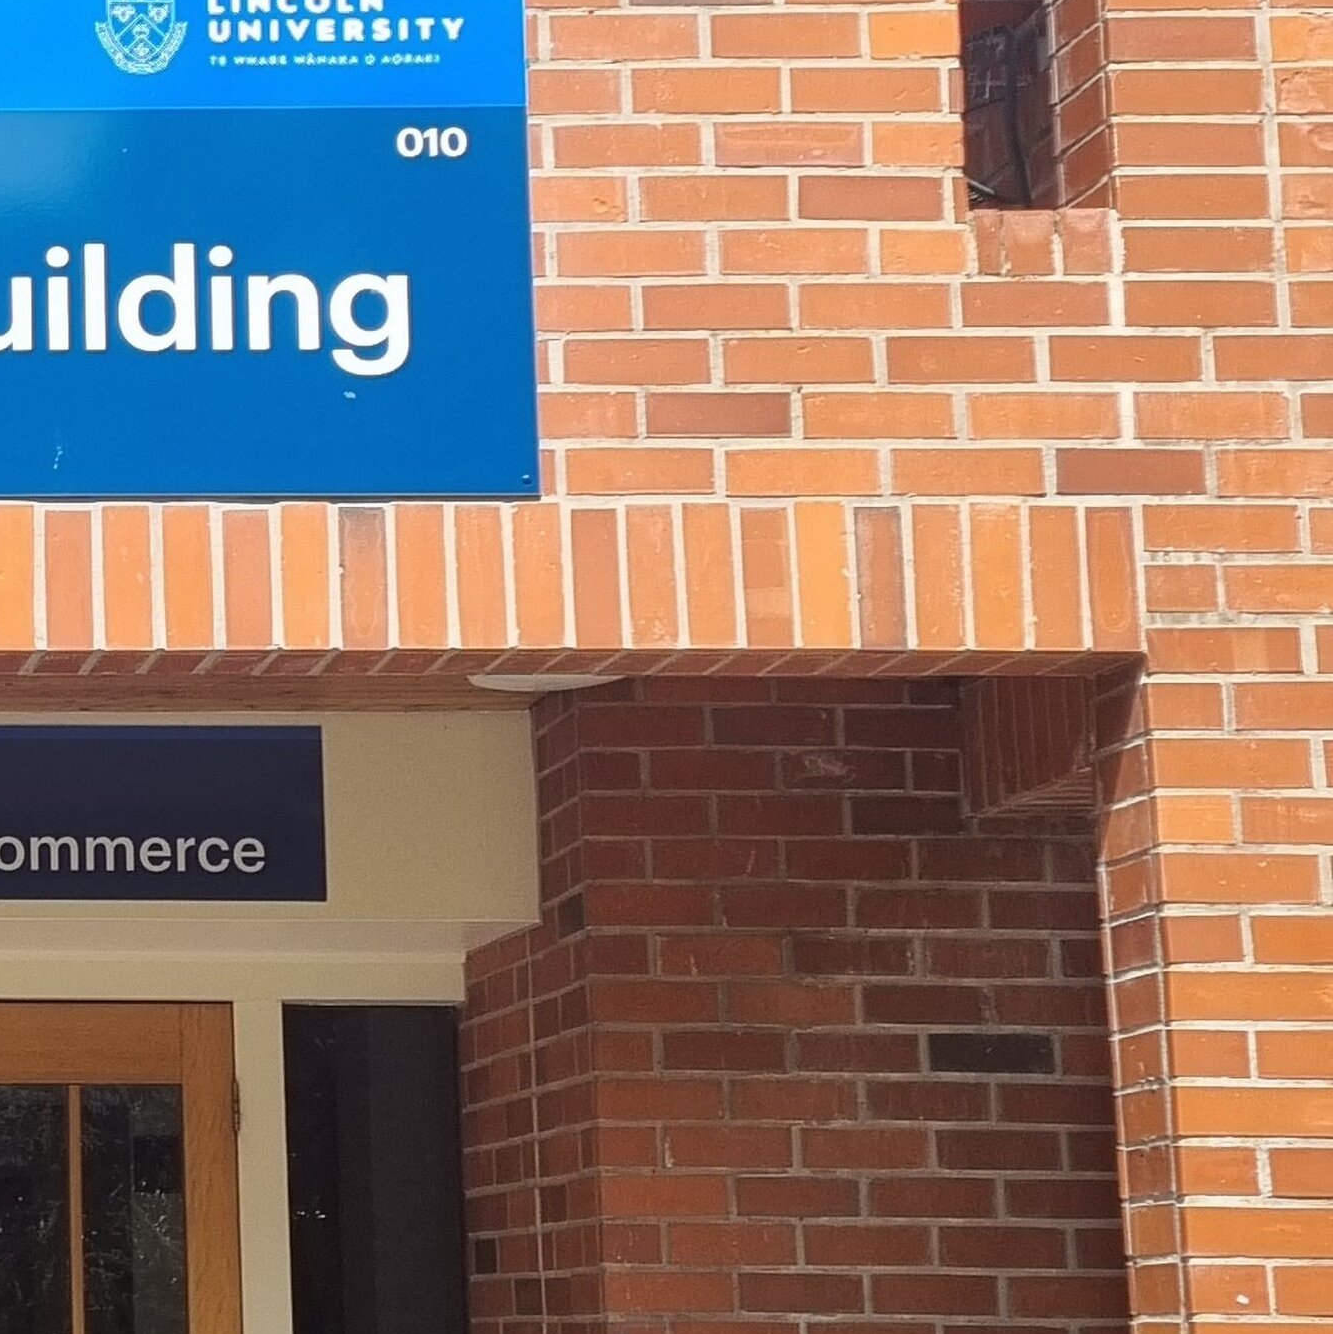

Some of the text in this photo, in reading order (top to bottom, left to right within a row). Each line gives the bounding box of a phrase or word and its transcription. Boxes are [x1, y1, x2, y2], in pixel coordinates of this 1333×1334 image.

[208, 18, 464, 42] UNIVERSITY
[210, 55, 227, 66] TE
[396, 126, 468, 157] 010
